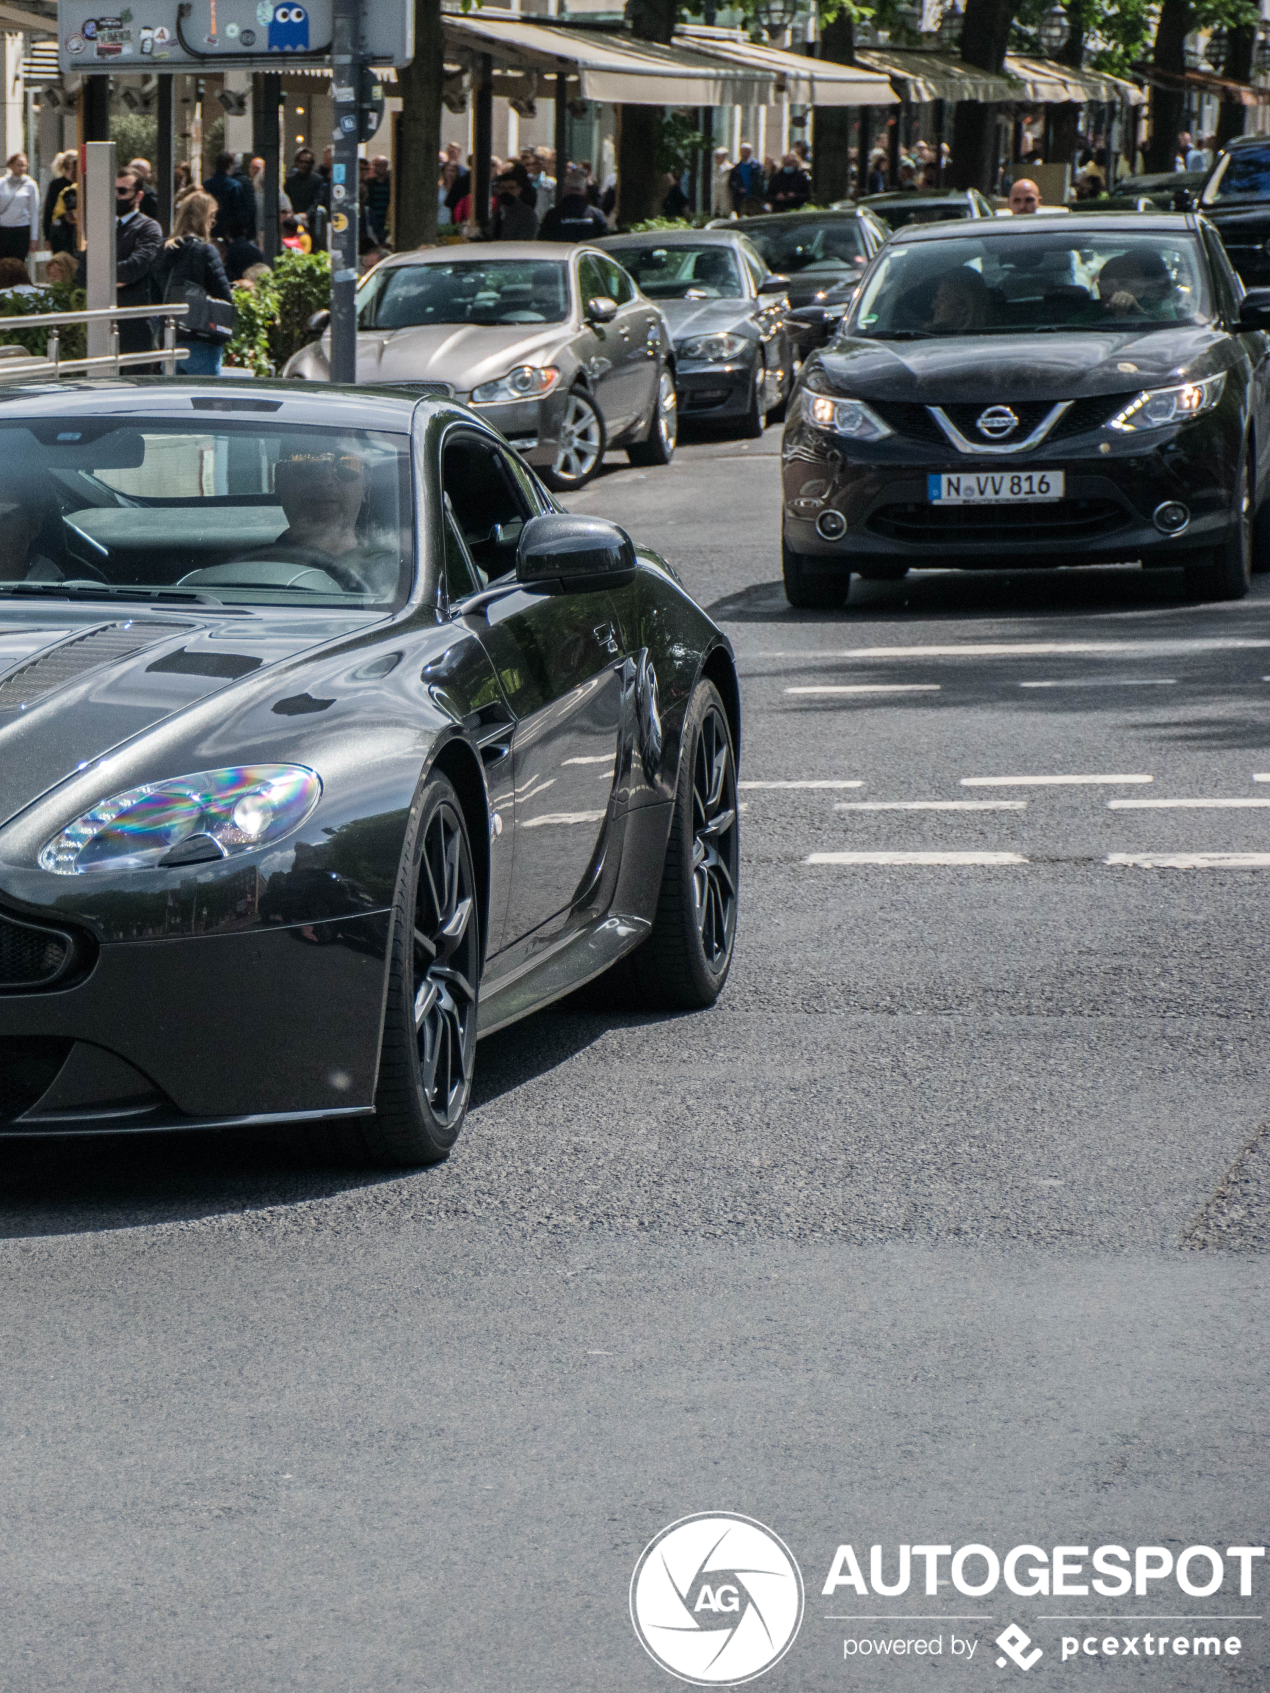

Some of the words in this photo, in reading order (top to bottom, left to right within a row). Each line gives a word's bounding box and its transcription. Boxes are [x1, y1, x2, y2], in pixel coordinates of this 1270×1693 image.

[946, 476, 961, 496] N
[976, 475, 1004, 496] VV
[1009, 474, 1051, 495] 816
